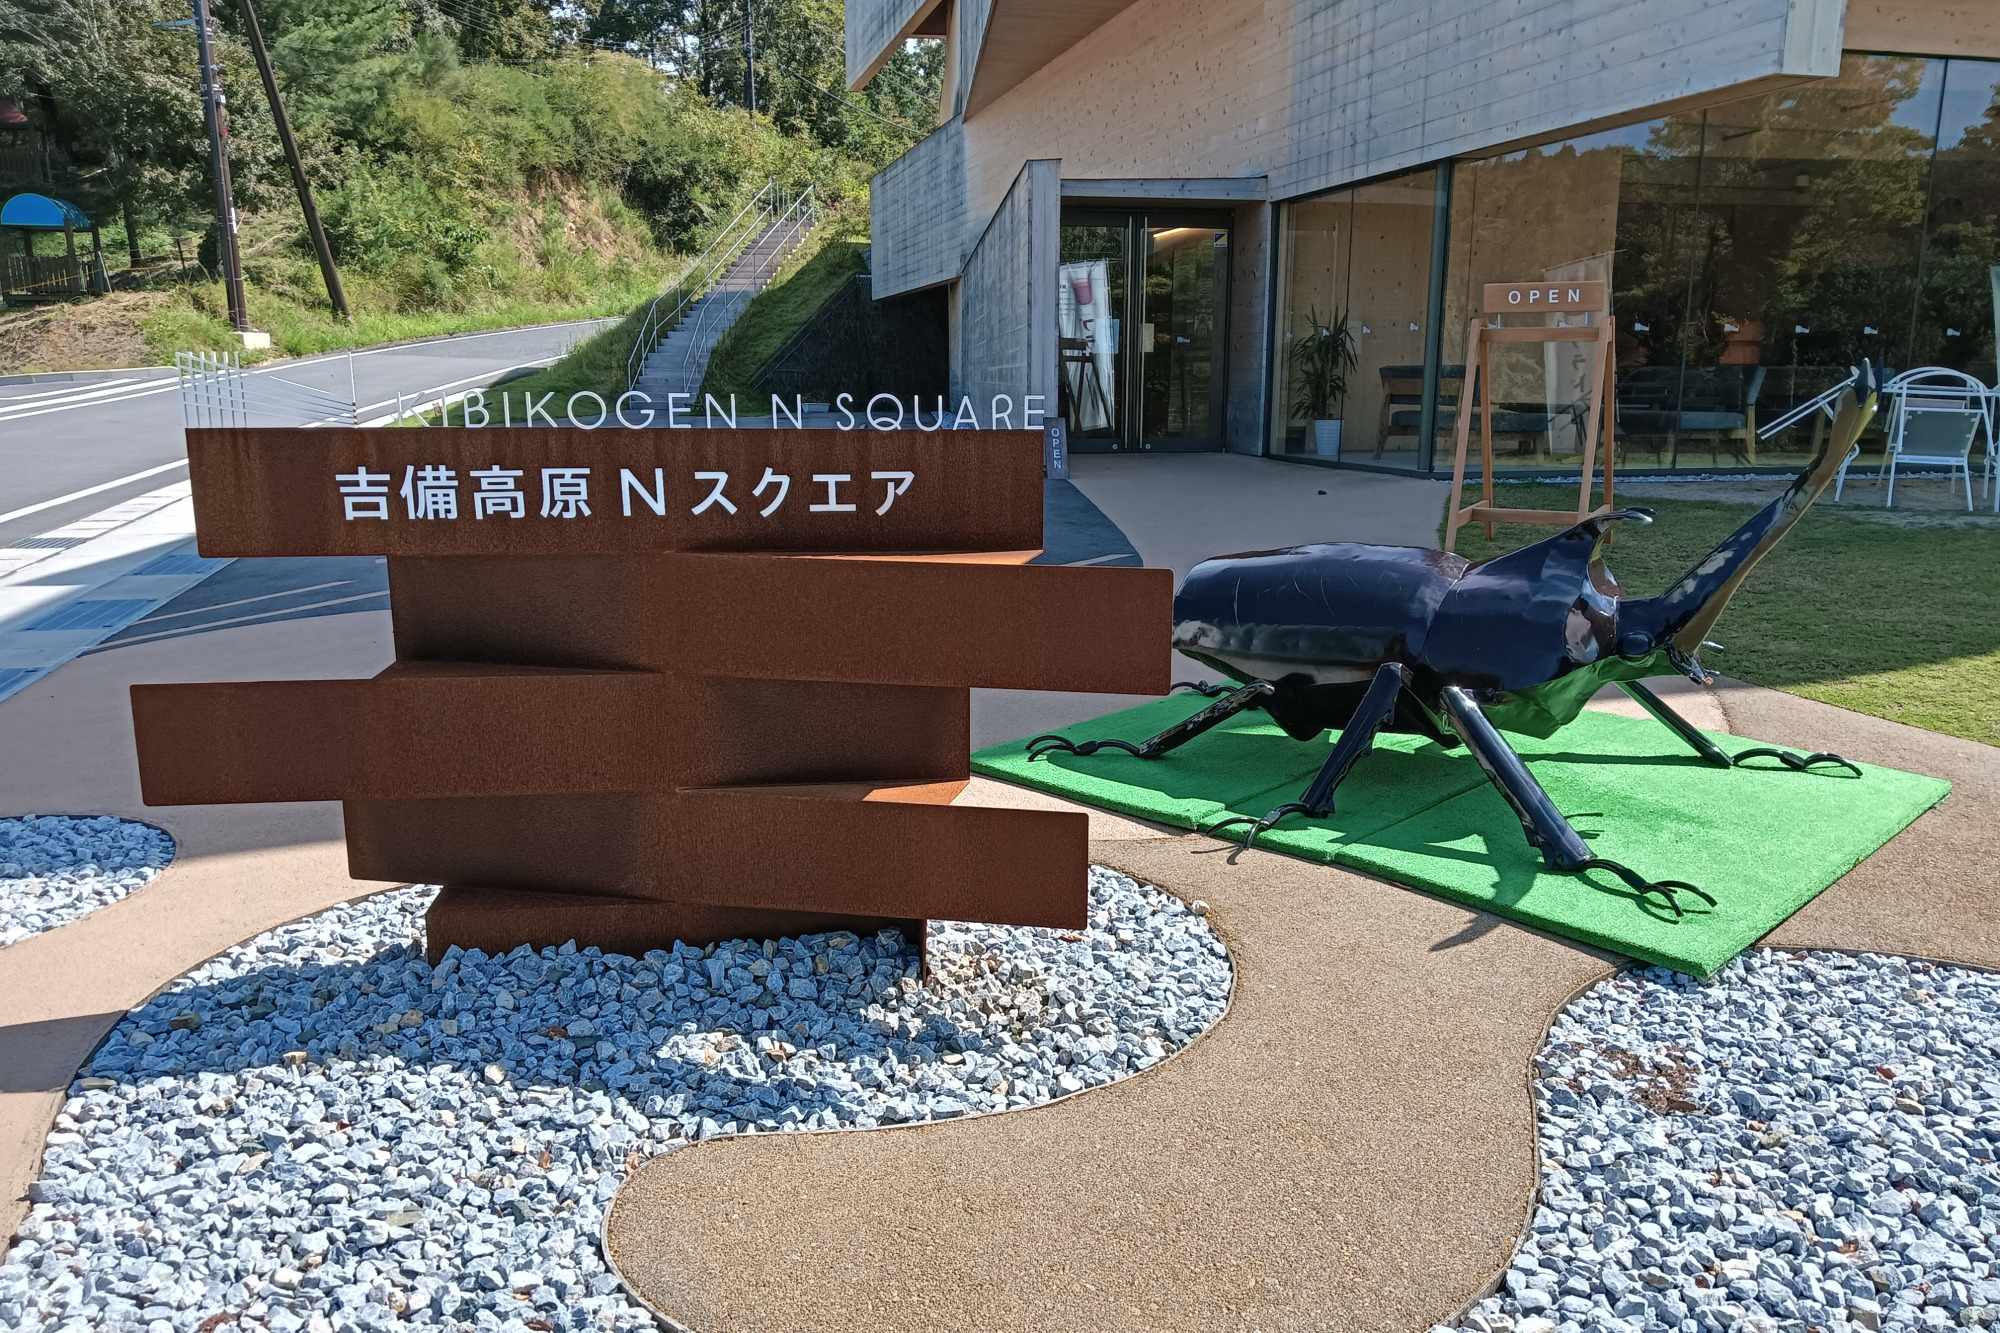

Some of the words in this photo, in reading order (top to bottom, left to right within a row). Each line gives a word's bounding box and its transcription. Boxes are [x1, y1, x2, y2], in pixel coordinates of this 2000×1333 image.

[1508, 289, 1580, 304] OPEN
[397, 390, 737, 429] KIBIKOGEN
[771, 393, 803, 429] N
[836, 392, 1046, 431] SQUARE
[1051, 428, 1062, 469] OPEN
